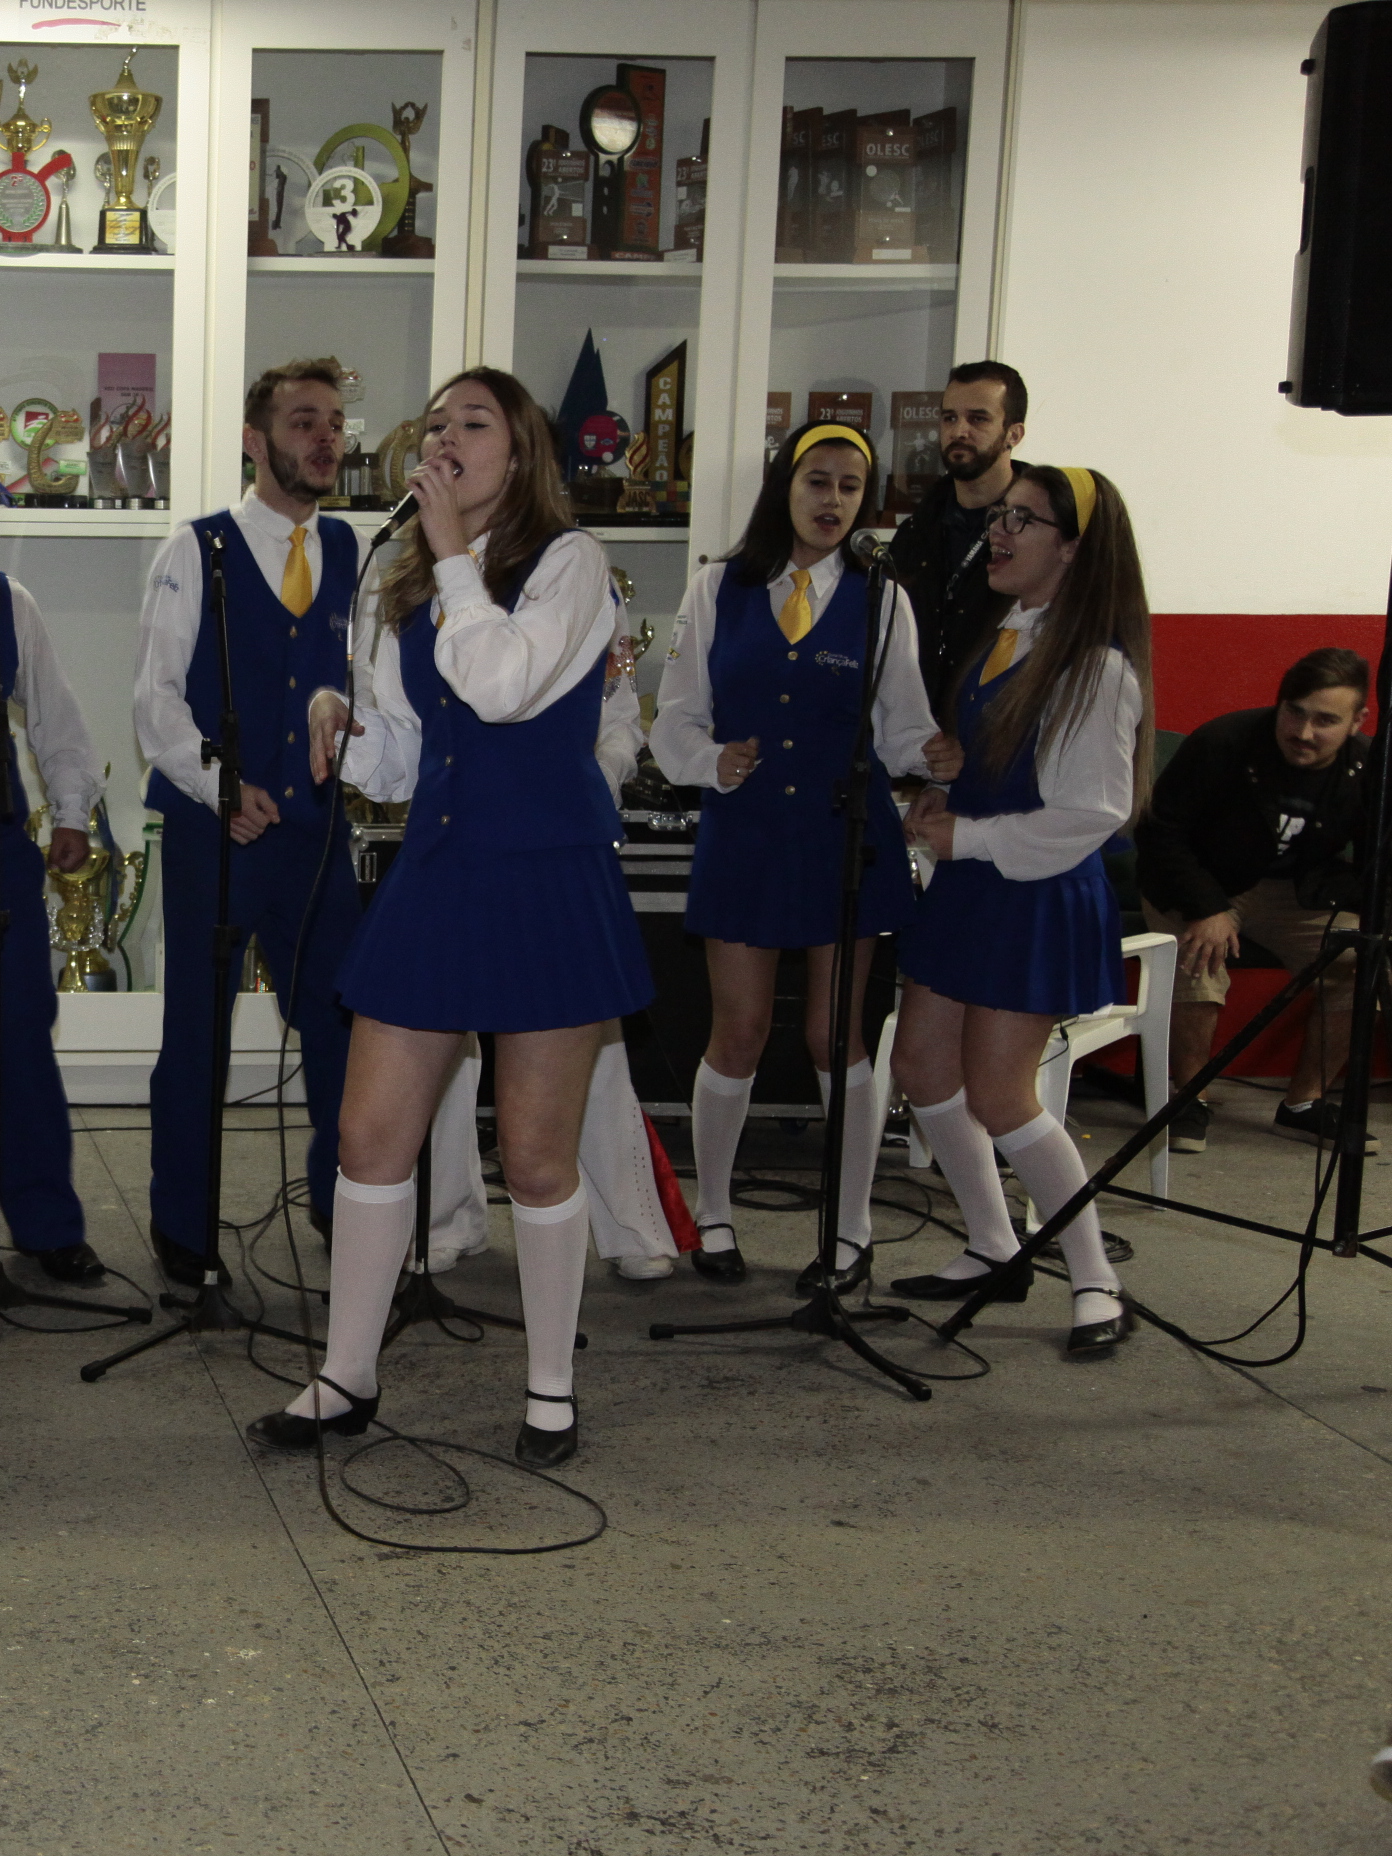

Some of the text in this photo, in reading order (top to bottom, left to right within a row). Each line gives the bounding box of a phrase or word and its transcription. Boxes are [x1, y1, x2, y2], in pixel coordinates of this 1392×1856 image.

[19, 0, 146, 11] FUNDESPORTE
[866, 143, 910, 157] OLESC
[332, 178, 356, 207] 3
[903, 407, 940, 419] OLESC
